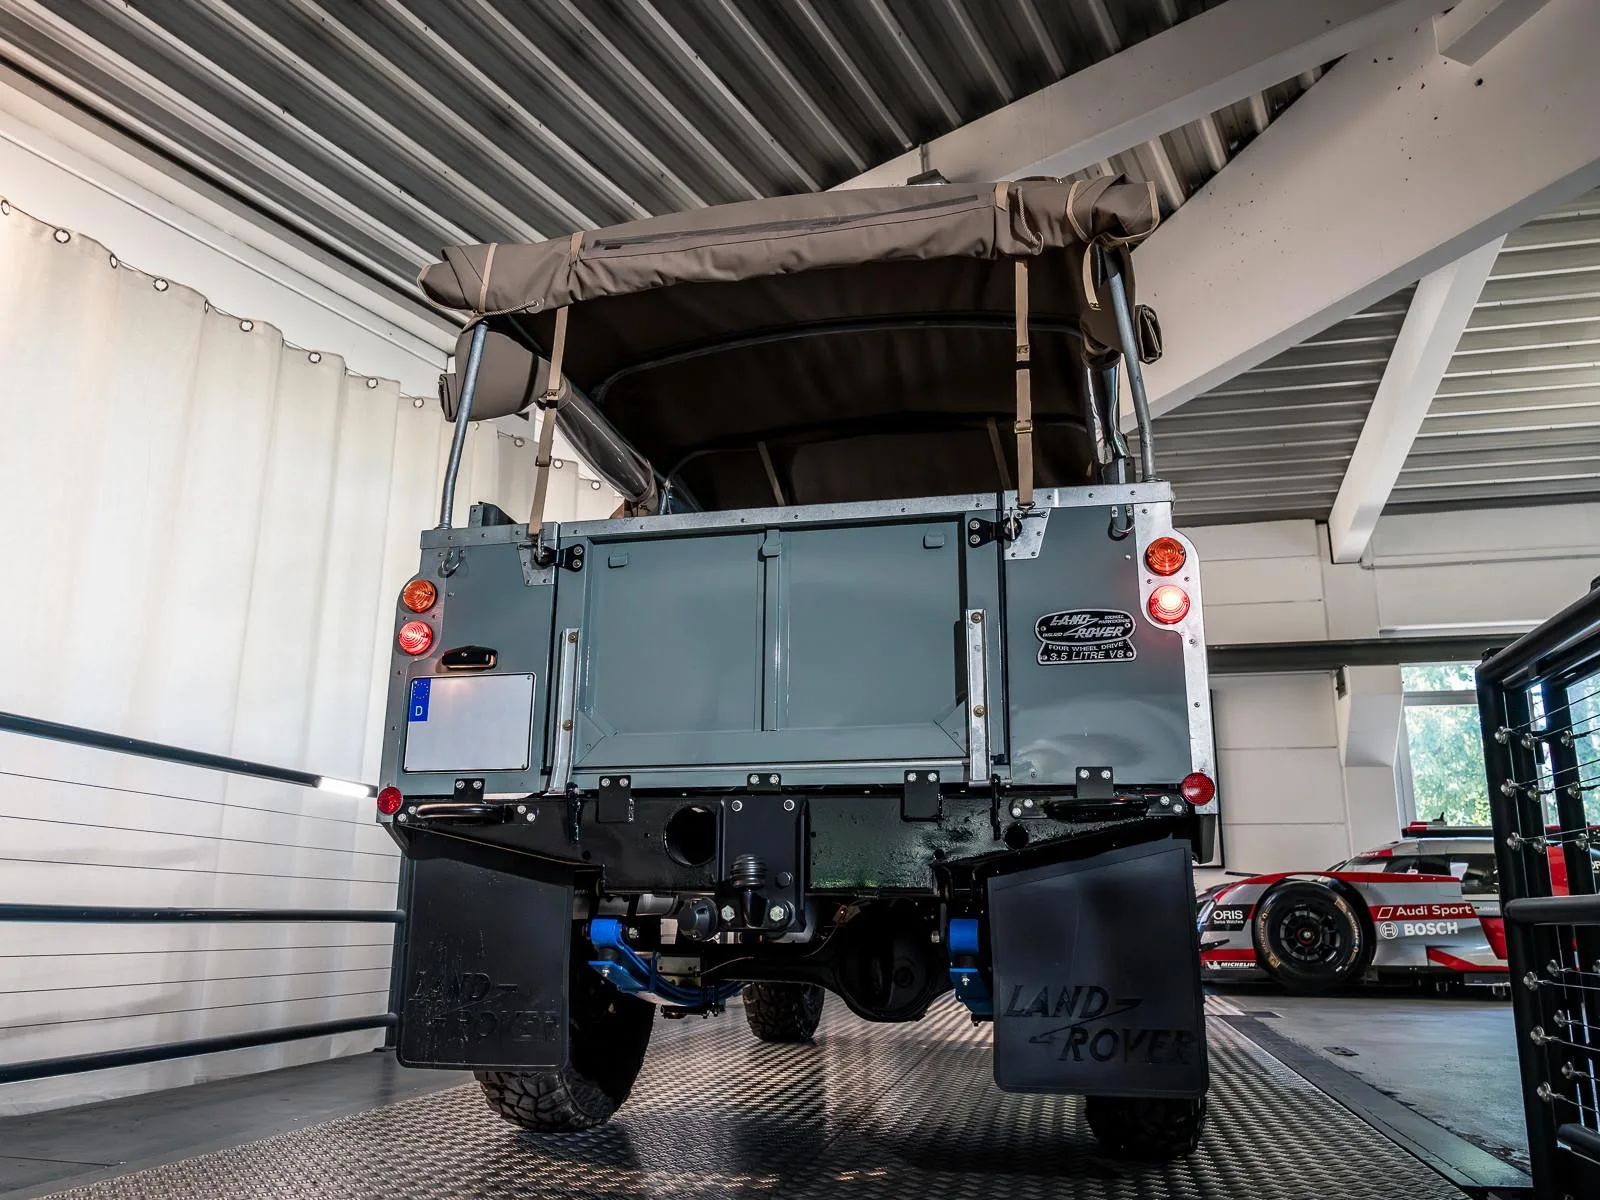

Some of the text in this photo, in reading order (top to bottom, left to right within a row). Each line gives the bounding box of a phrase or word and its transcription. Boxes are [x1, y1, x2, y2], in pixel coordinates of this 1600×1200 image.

[1050, 614, 1091, 626] LAND
[1074, 626, 1124, 639] ROVER
[1048, 641, 1124, 652] FOUR WHEEL DRIVE
[1049, 650, 1124, 661] 3.5 LITRE V8
[415, 705, 423, 717] D
[1213, 910, 1244, 920] ORIS
[1396, 905, 1428, 916] Audi
[1432, 904, 1472, 917] Sport
[1403, 921, 1459, 937] BOSCH
[1003, 984, 1110, 1019] LAND
[1057, 1026, 1198, 1065] ROVER
